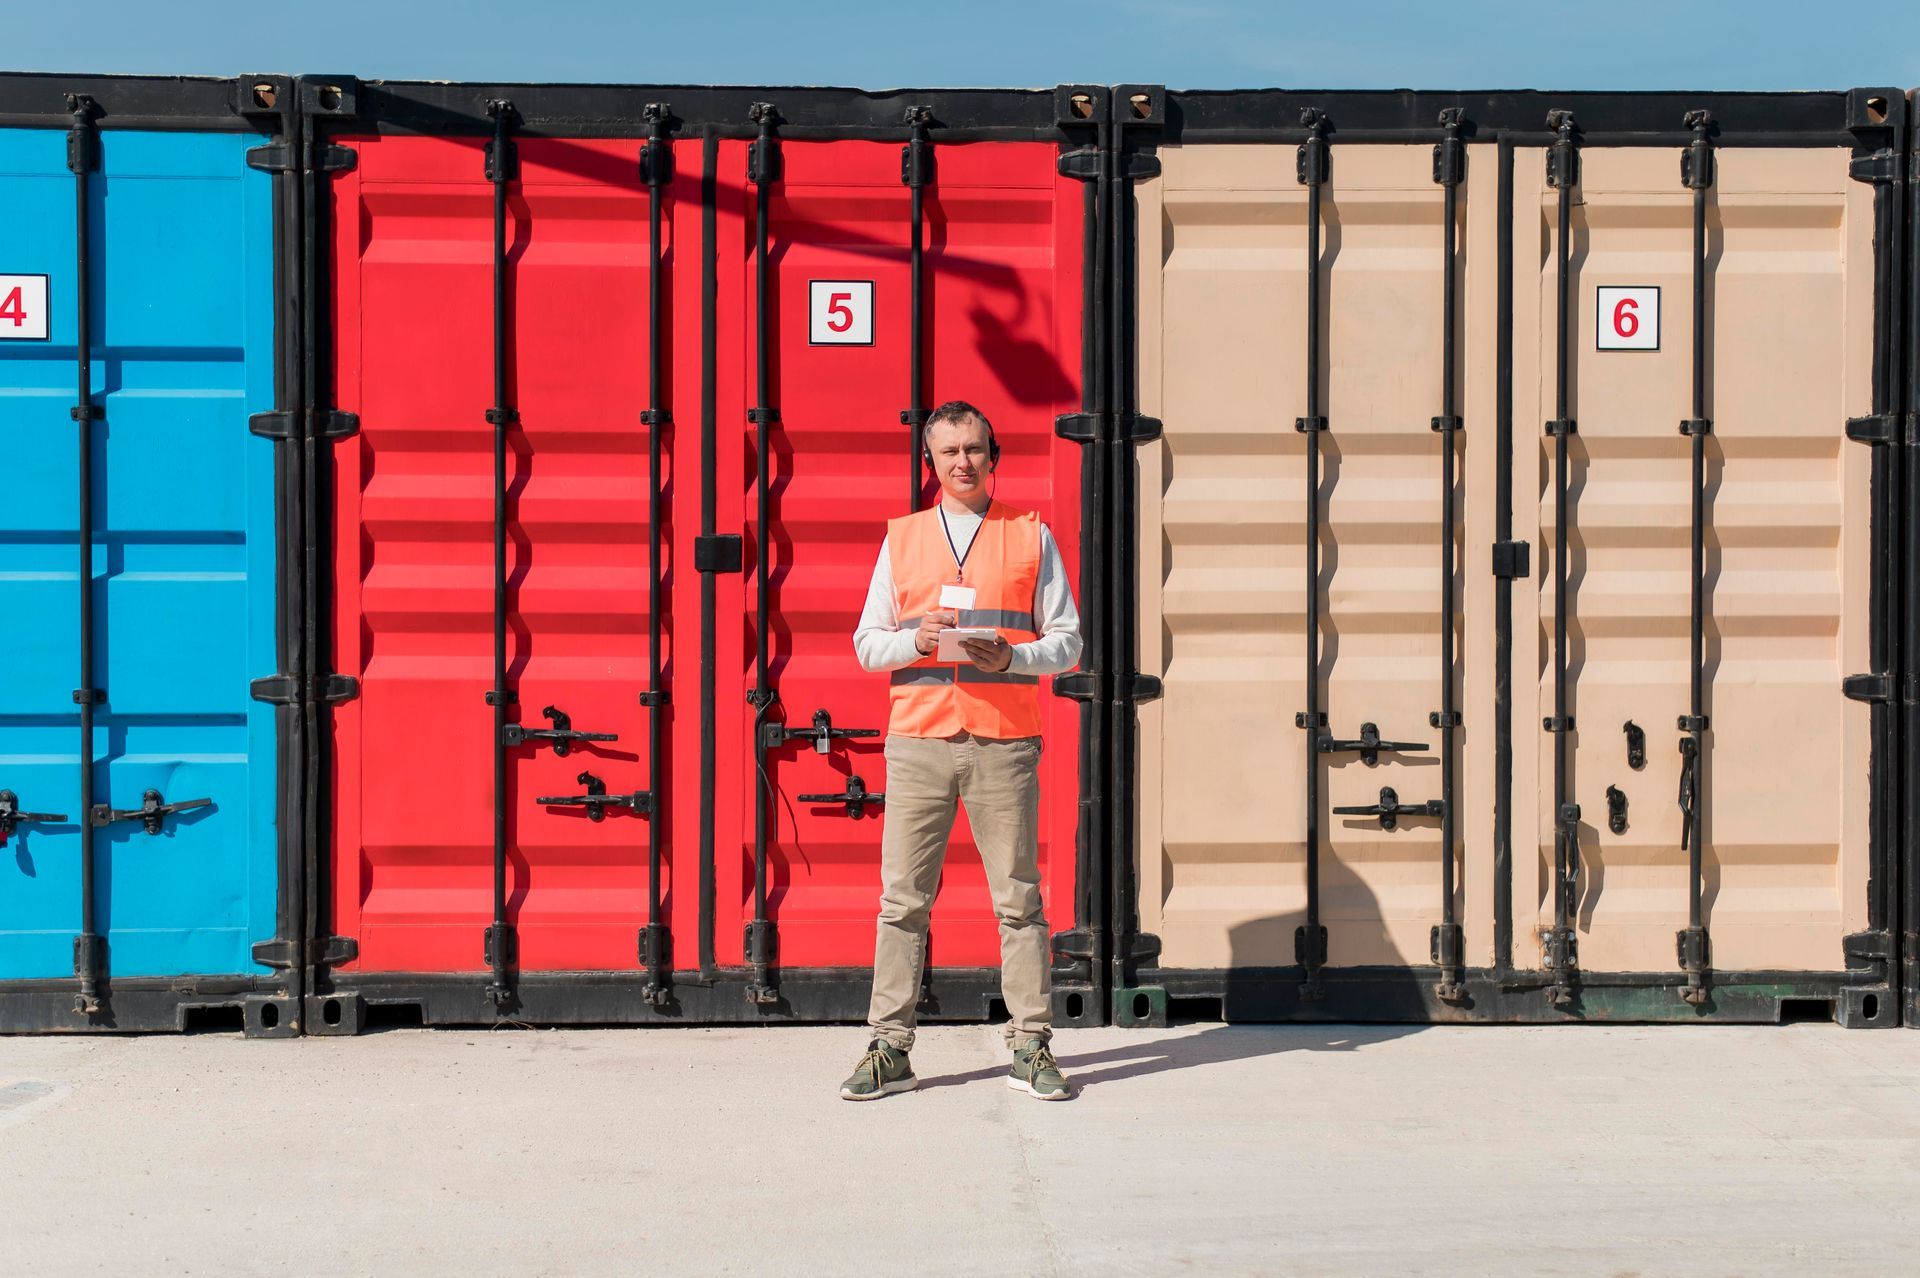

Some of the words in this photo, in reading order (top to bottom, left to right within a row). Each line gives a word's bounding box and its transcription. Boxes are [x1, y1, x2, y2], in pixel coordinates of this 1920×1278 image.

[0, 287, 27, 327] 4
[827, 293, 854, 332] 5
[1613, 298, 1640, 337] 6
